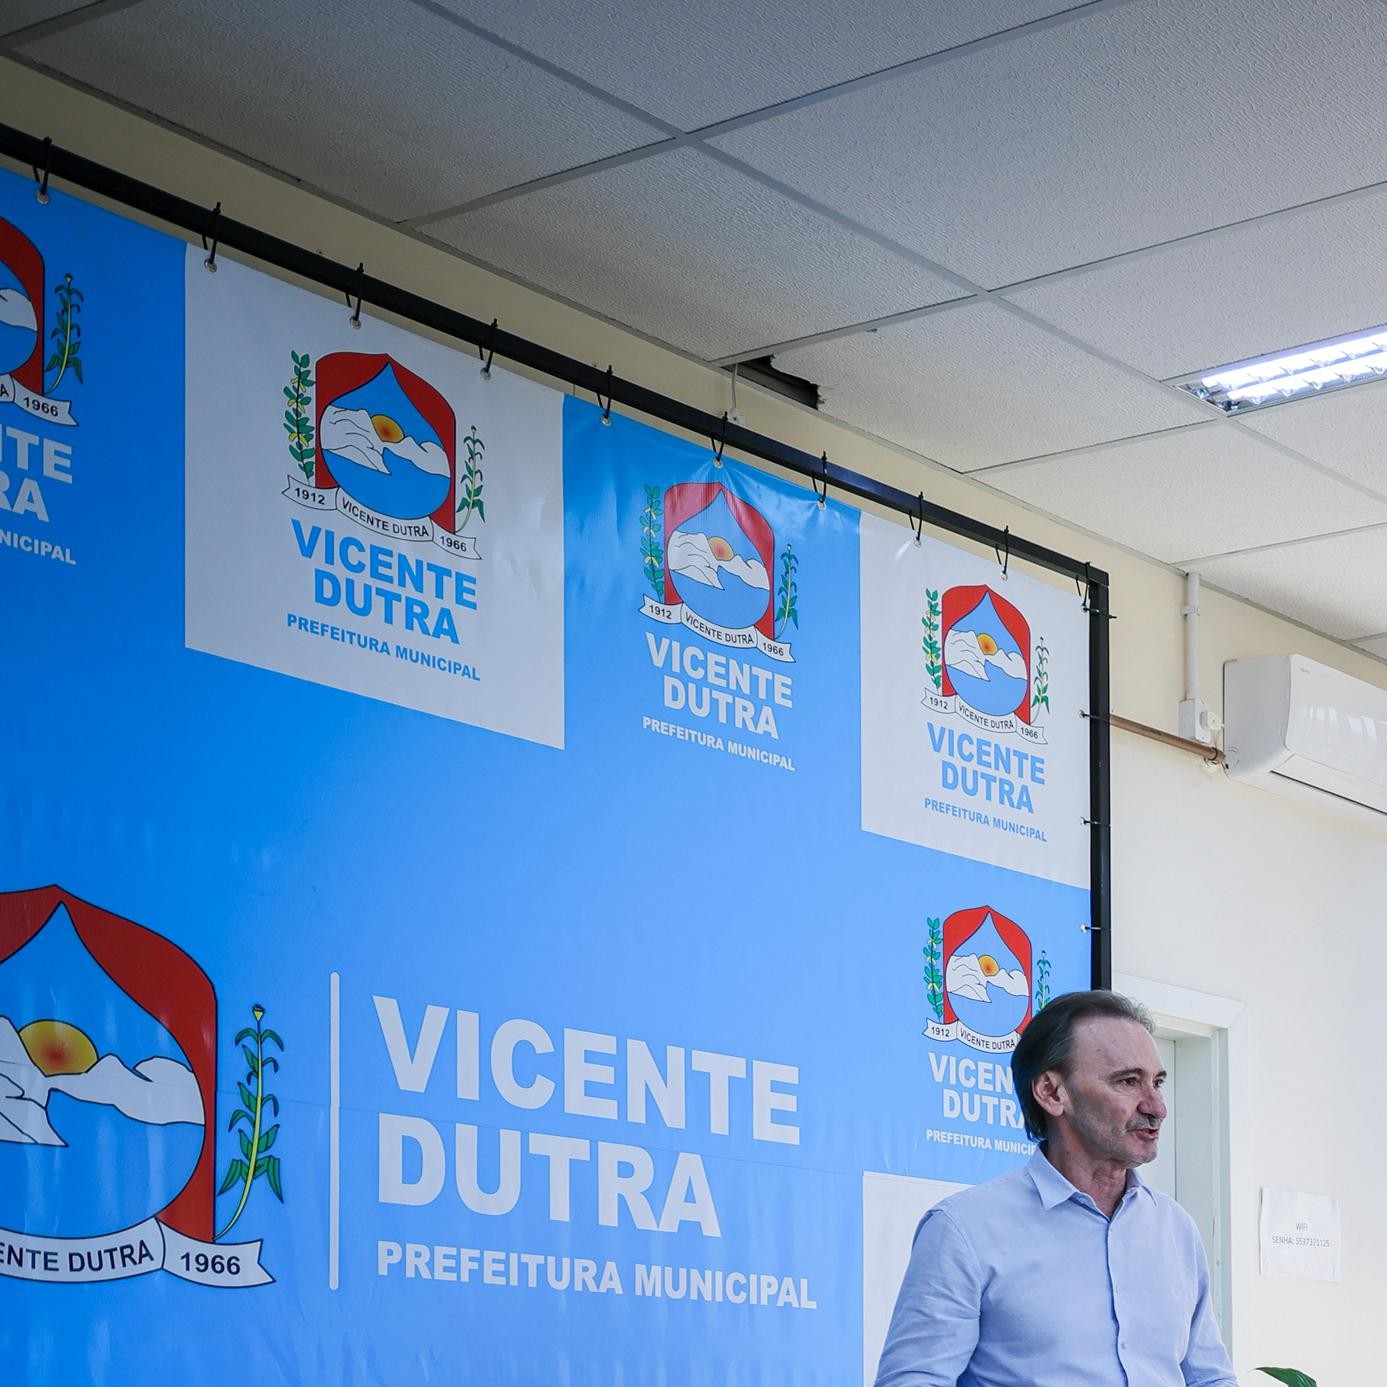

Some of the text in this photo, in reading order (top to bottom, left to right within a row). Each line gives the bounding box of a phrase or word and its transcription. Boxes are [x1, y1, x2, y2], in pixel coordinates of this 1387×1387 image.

[24, 397, 59, 417] 1966
[294, 487, 325, 505] 1912
[342, 497, 430, 537] VICENTE DUTRA
[439, 535, 467, 552] 1966
[291, 518, 477, 610] VICENTE
[314, 568, 460, 645] DUTRA
[649, 605, 672, 619] 1912
[685, 611, 754, 645] VICENTE DUTRA
[287, 613, 481, 681] PREFEITURA MUNICIPAL
[762, 642, 784, 656] 1966
[645, 632, 793, 708] VICENTE
[663, 675, 779, 740] DUTRA
[929, 697, 948, 710] 1912
[959, 702, 1014, 729] VICENTE DUTRA
[642, 716, 796, 772] PREFEITURA MUNICIPAL
[1020, 727, 1038, 739] 1966
[927, 722, 1046, 785] VICENTE
[942, 760, 1034, 814] DUTRA
[924, 798, 1047, 842] PREFEITURA MUNICIPAL
[931, 1026, 950, 1038] 1912
[960, 1028, 1015, 1050] VICENTE DUTRA
[372, 995, 800, 1145] VICENTE
[926, 1129, 992, 1150] PREFEITURA
[378, 1112, 722, 1238] DUTRA
[68, 1240, 154, 1272] DUTRA
[180, 1252, 241, 1276] 1966
[377, 1240, 818, 1310] PREFEITURA MUNICIPAL
